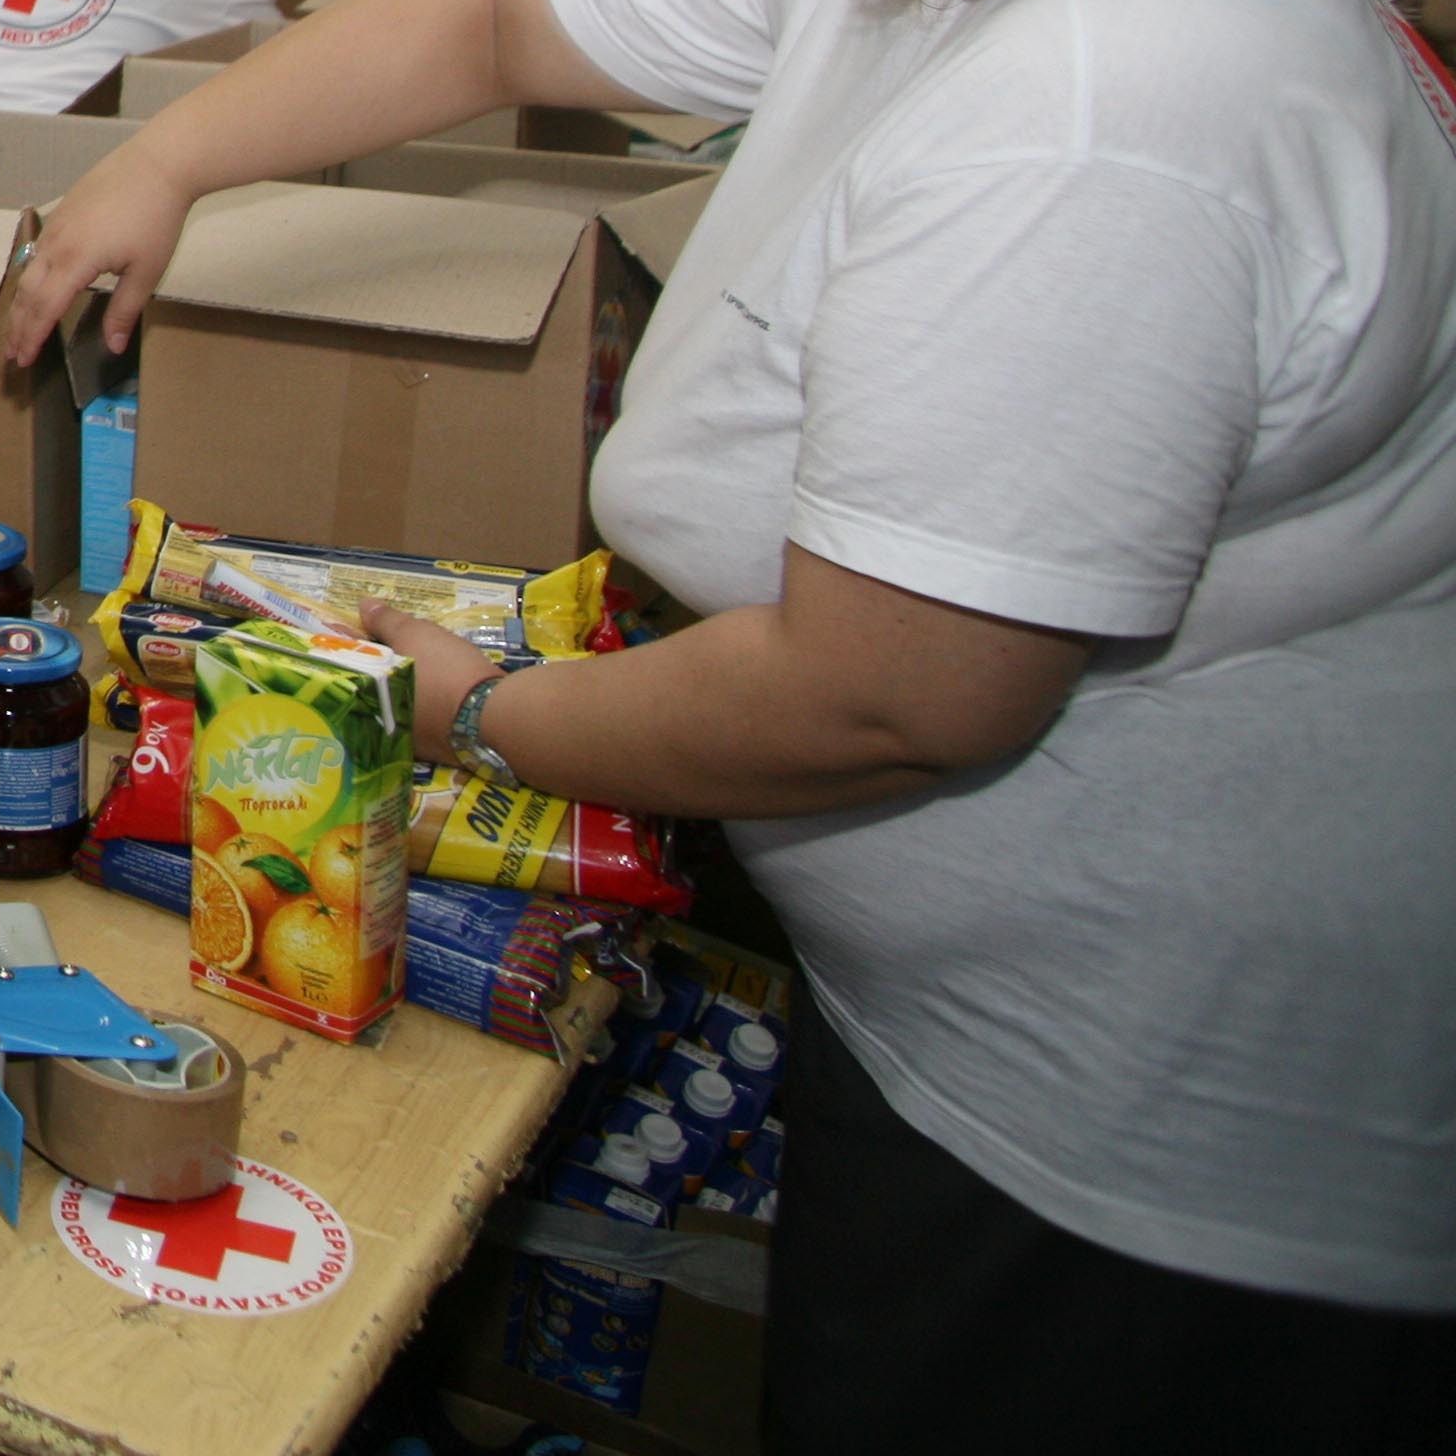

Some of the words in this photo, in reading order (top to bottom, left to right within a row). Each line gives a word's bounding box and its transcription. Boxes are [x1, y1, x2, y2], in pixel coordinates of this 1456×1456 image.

[0, 28, 34, 44] RED
[60, 1190, 81, 1223] RED
[231, 1157, 335, 1225] ΛΗΝΙΚΟΣ
[288, 1227, 347, 1300] ΕΡΥΘΡΟΣ
[64, 1224, 128, 1281] CROSS
